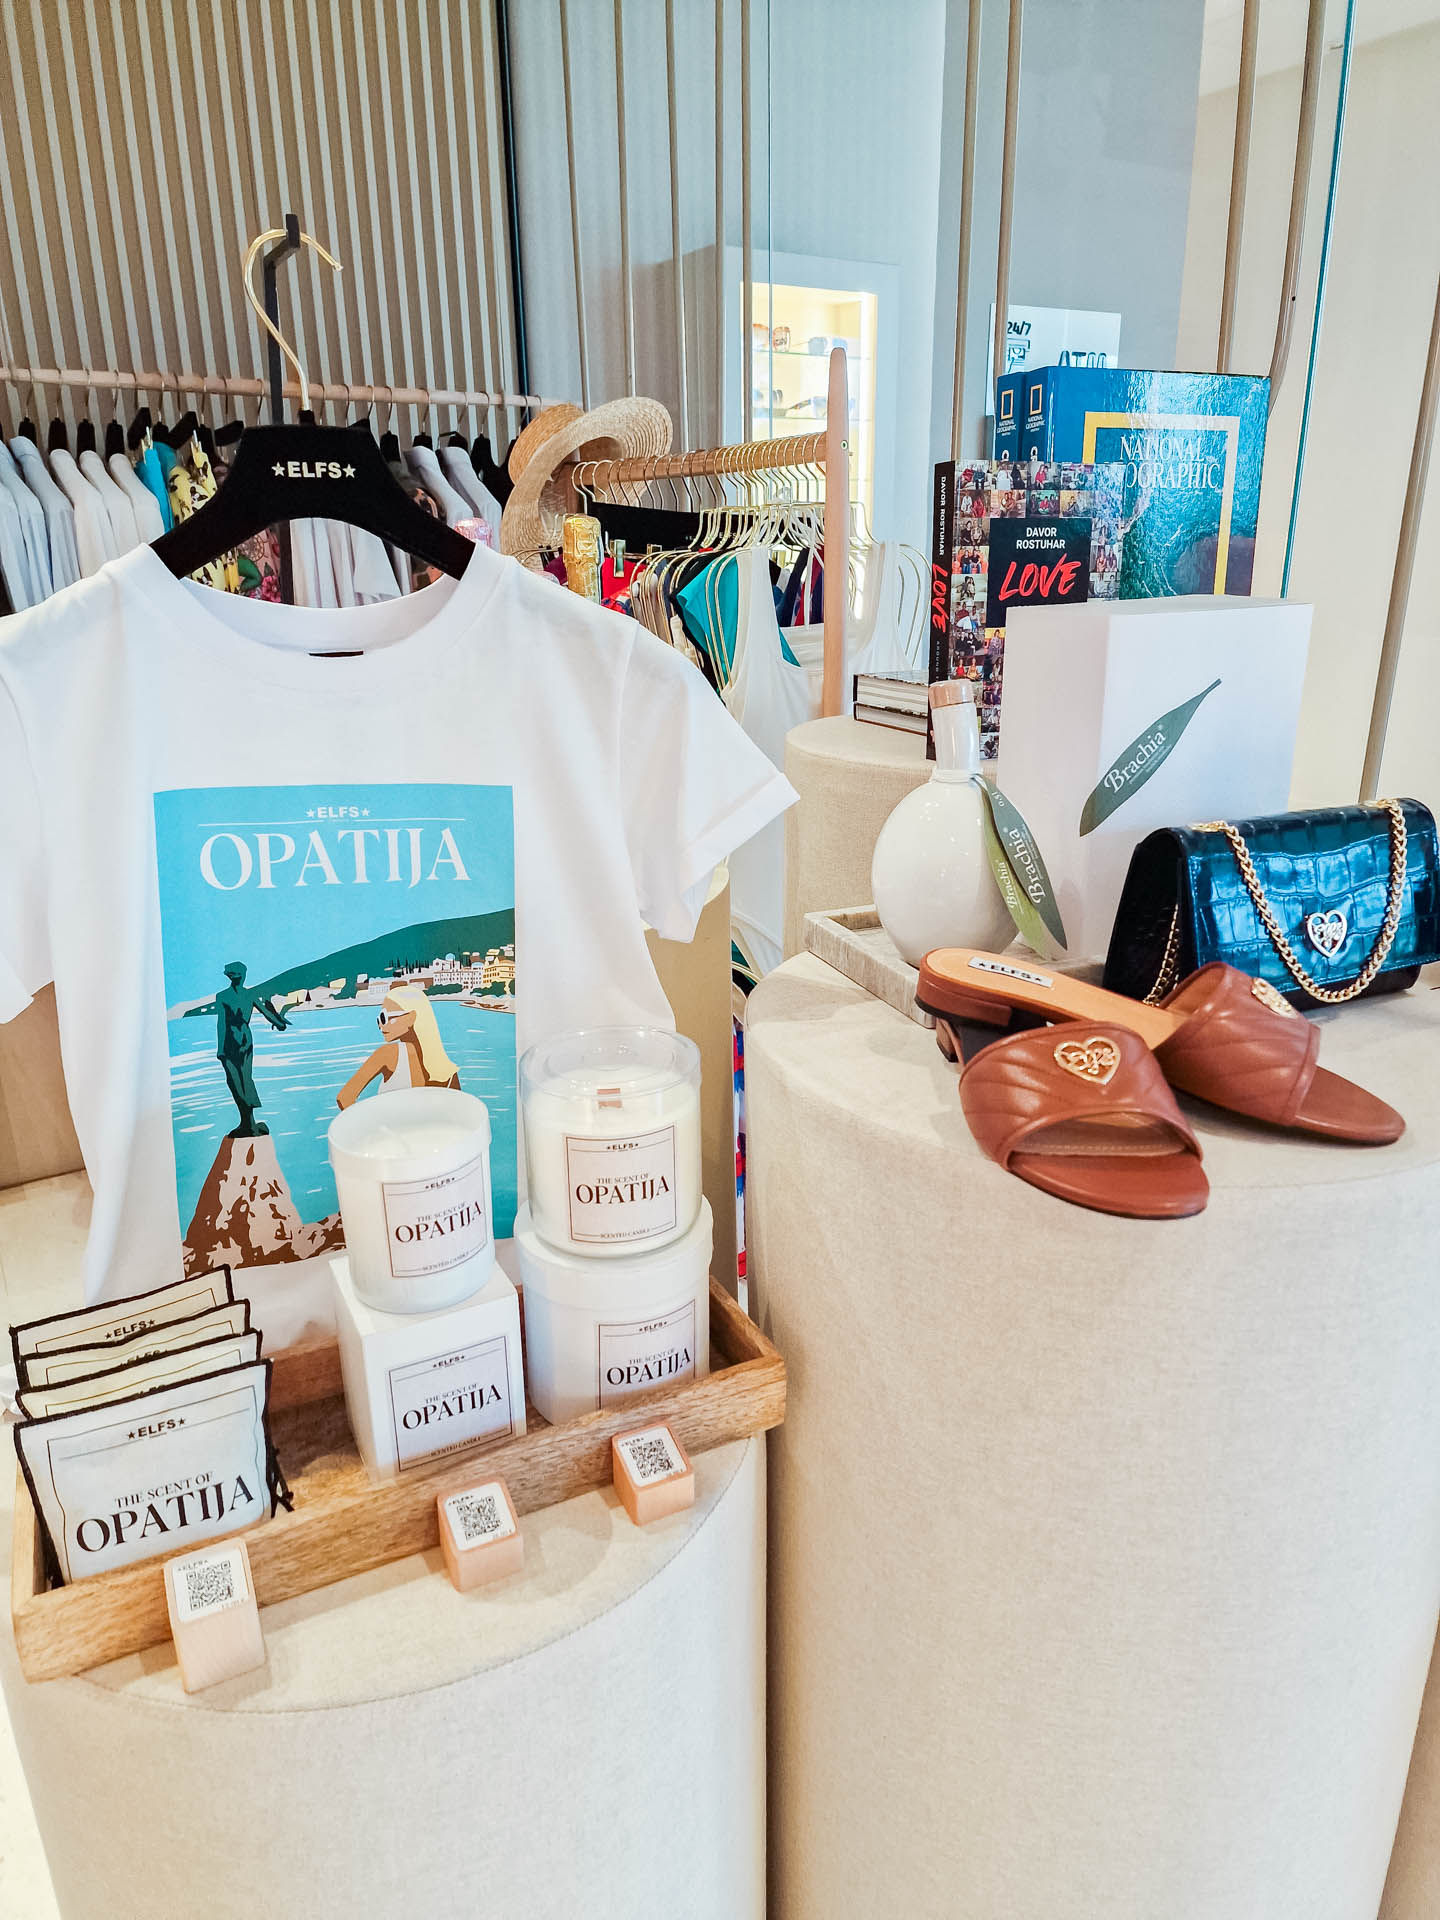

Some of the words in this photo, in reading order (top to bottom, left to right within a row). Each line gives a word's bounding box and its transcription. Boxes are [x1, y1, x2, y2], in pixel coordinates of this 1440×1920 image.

[1007, 320, 1032, 337] 24/7
[1120, 435, 1205, 462] NATIONAL
[287, 460, 343, 479] ELFS
[1125, 461, 1220, 489] OGRAPHIC
[1026, 526, 1057, 538] DAVOR
[1016, 538, 1066, 550] ROSTUHAR
[998, 552, 1082, 601] LOVE
[932, 562, 950, 633] LOVE
[1103, 731, 1167, 793] Brachia
[317, 806, 360, 818] ELFS
[199, 827, 472, 891] OPATIJA
[1008, 827, 1046, 904] Brachia
[990, 964, 1031, 979] ELFS
[612, 1143, 634, 1151] ELFS
[430, 1178, 451, 1189] ELFS
[576, 1175, 670, 1205] OPATIJA
[394, 1201, 482, 1243] OPATIJA
[113, 1320, 147, 1338] ELFS
[644, 1321, 663, 1332] ELFS
[438, 1355, 460, 1367] ELFS
[606, 1347, 691, 1386] OPATIJA
[402, 1384, 502, 1430] OPATIJA
[425, 1396, 439, 1404] THE
[138, 1418, 176, 1438] ELFS
[114, 1490, 144, 1509] THE
[147, 1477, 193, 1501] SCENT
[195, 1471, 214, 1485] OF
[76, 1474, 254, 1552] OPATIJA
